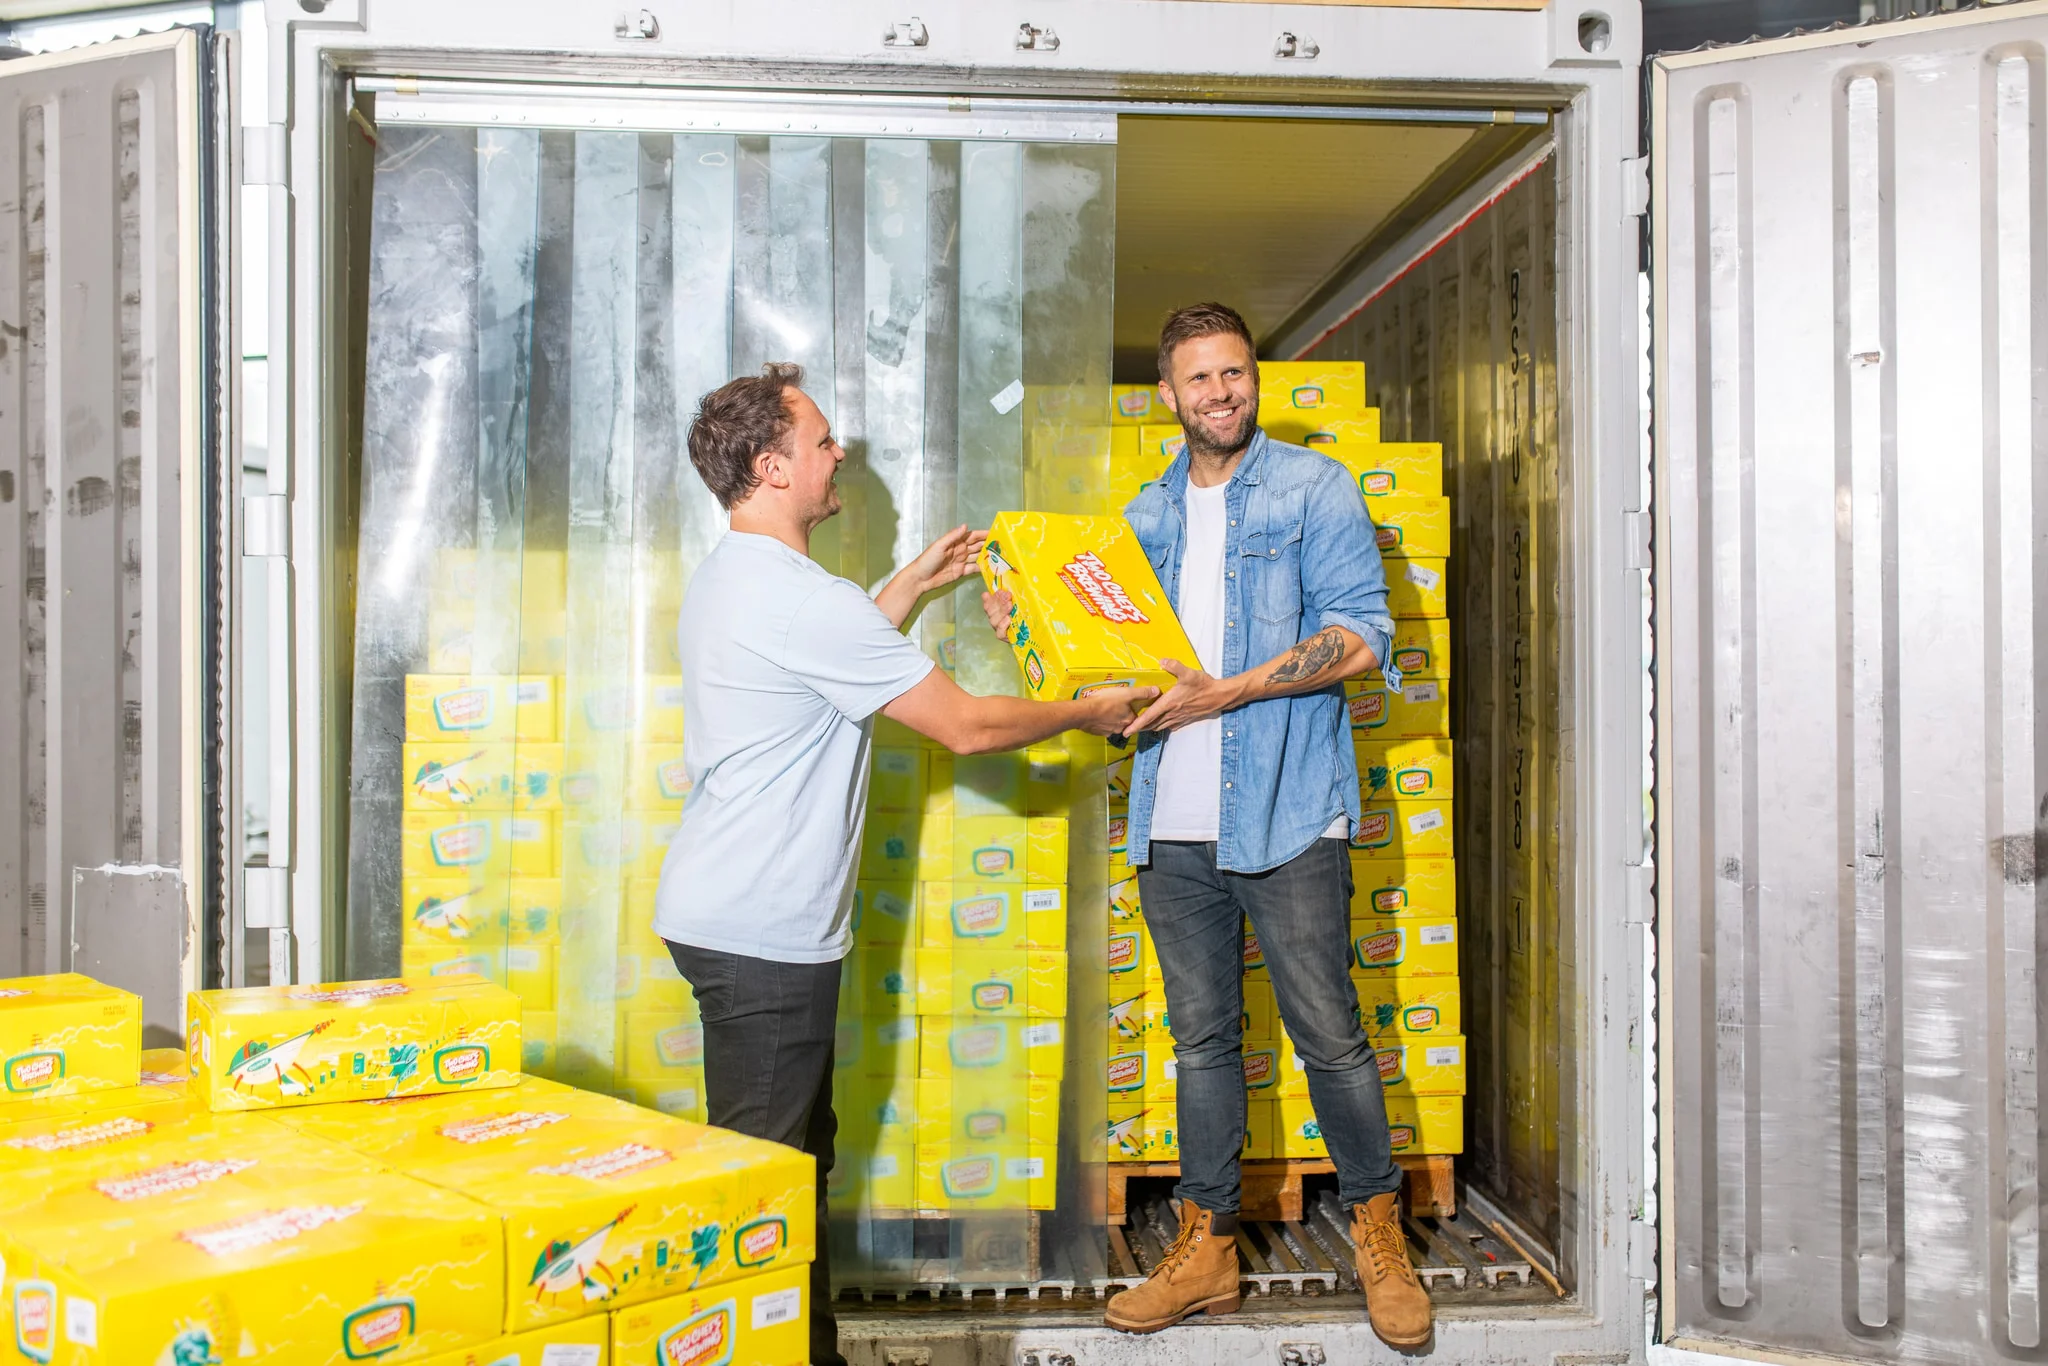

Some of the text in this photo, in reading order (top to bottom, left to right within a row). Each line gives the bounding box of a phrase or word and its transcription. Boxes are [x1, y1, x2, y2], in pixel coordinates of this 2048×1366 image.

[1062, 561, 1129, 624] BREWING
[1074, 550, 1151, 624] TWO CHEFS
[1360, 695, 1382, 707] CHEFS
[1352, 703, 1381, 718] BREWING
[1362, 934, 1397, 952] TWO CHEFS
[1368, 943, 1397, 958] BREWING
[1377, 1052, 1398, 1065] CHEFS
[668, 1313, 723, 1359] TWO CHEFS
